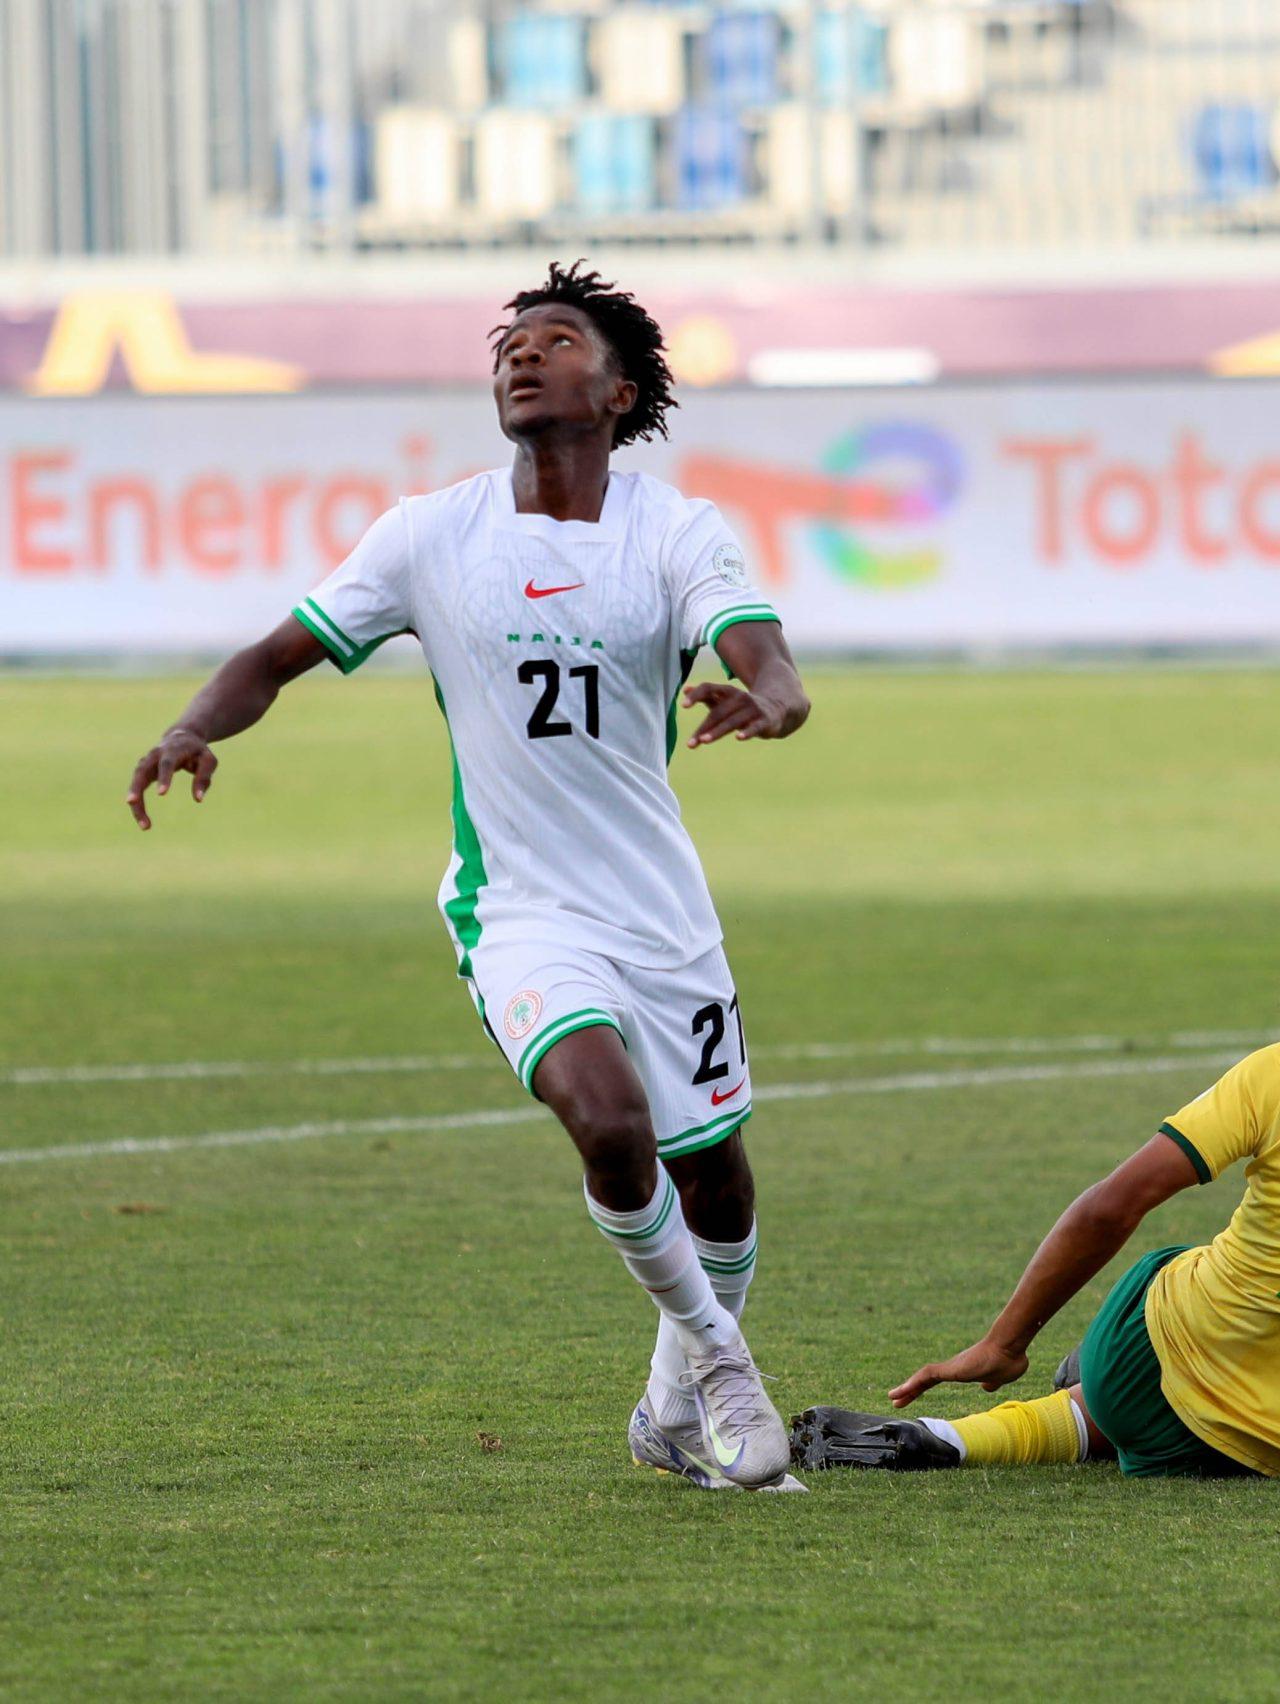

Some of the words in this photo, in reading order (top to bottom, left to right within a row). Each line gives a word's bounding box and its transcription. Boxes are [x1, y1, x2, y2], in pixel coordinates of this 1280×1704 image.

[6, 432, 492, 592] Ener
[506, 633, 604, 650] NAIJA
[517, 659, 600, 740] 21
[691, 992, 746, 1086] 21
